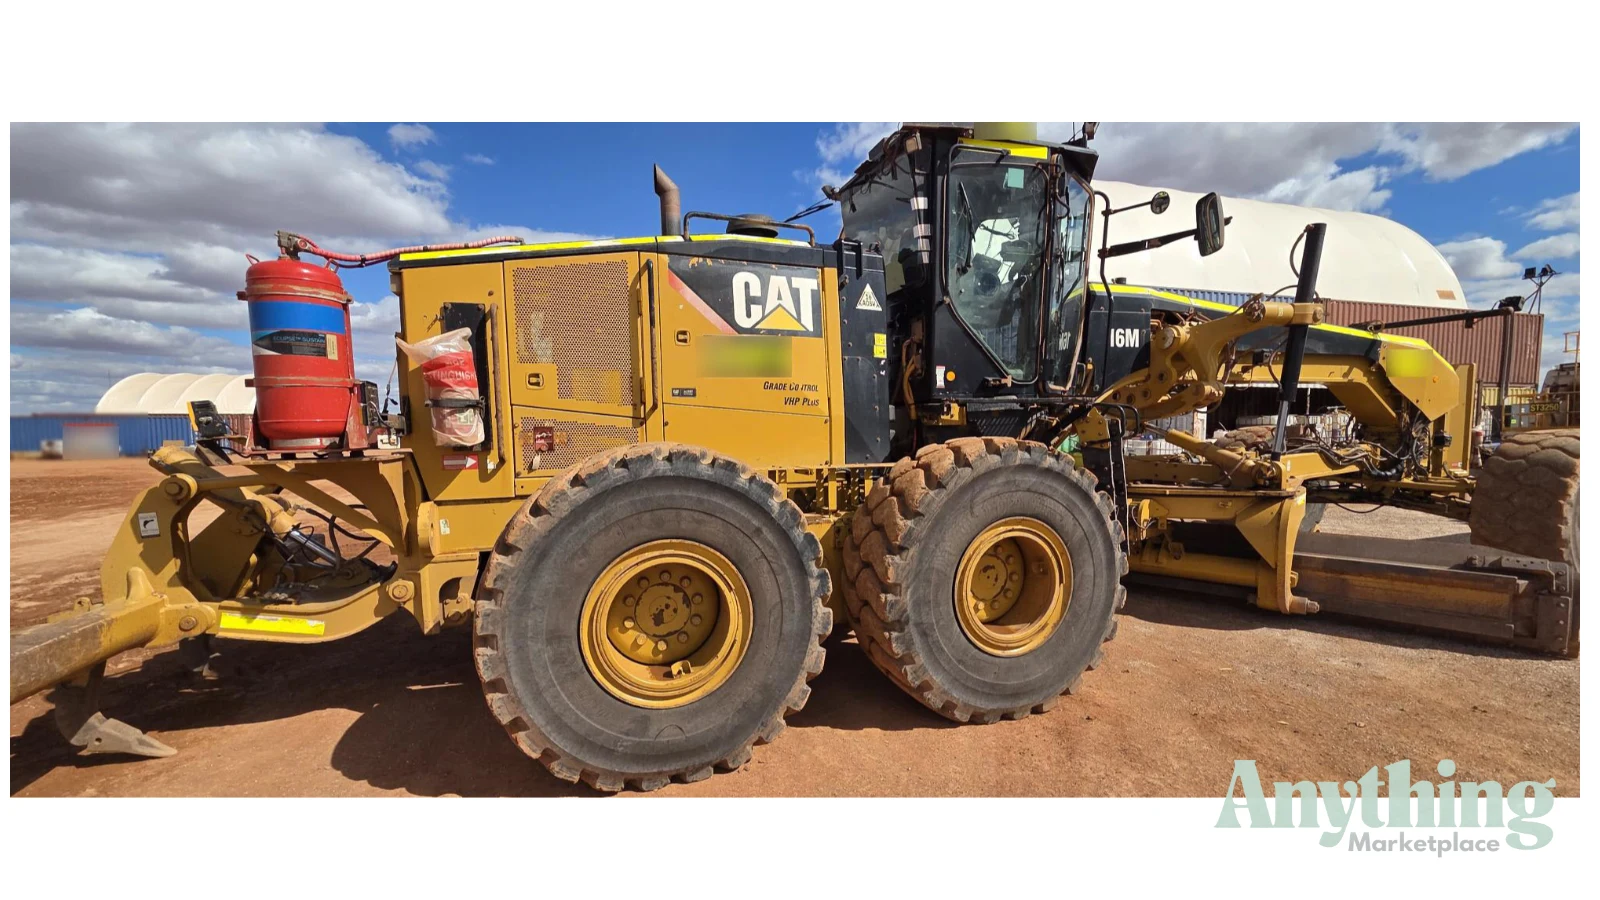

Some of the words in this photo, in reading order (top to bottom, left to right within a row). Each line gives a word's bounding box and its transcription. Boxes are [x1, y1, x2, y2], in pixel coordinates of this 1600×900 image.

[732, 271, 818, 332] CAT
[1110, 328, 1140, 348] 16M
[784, 396, 801, 406] VHP
